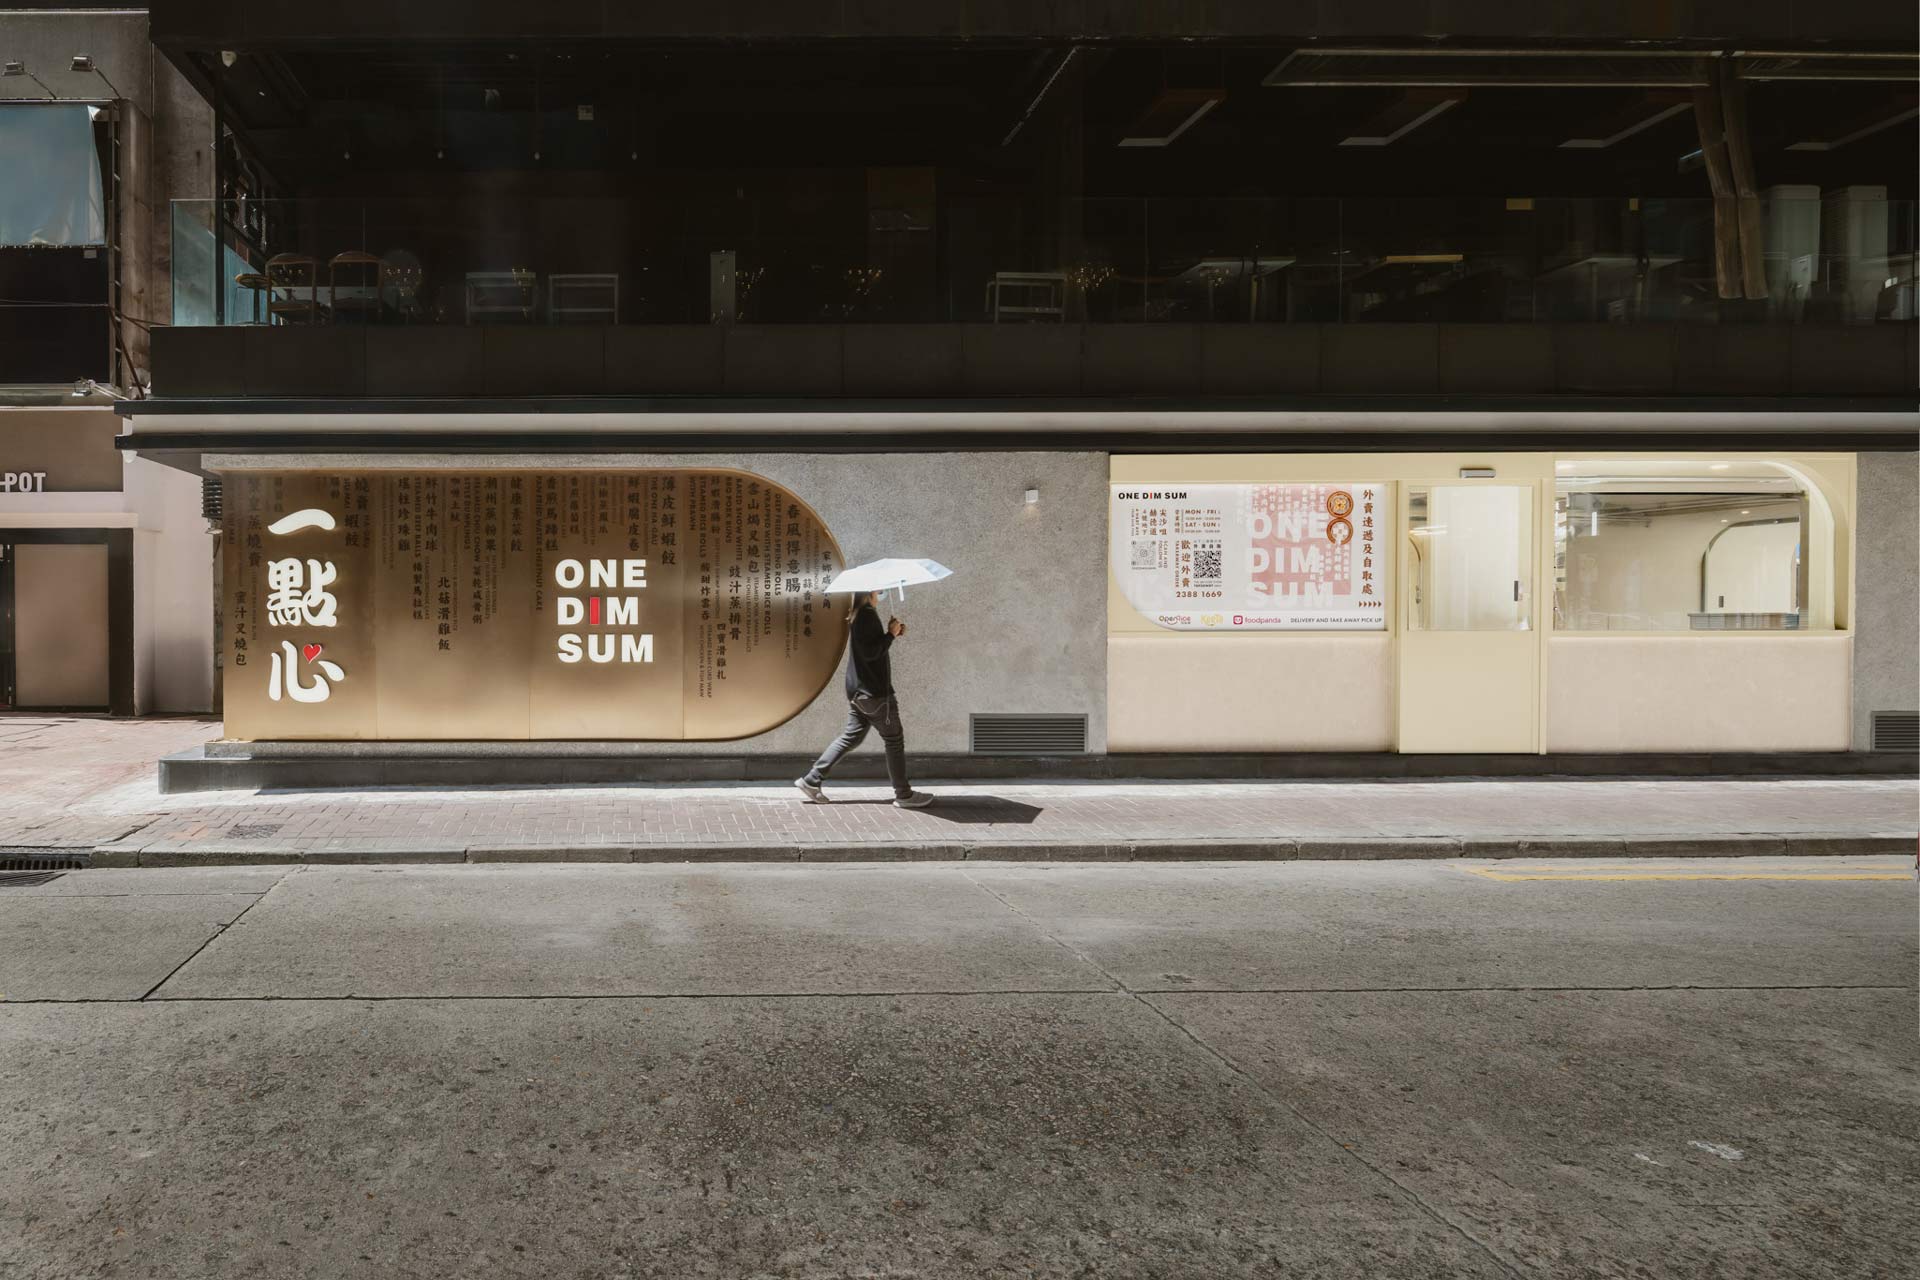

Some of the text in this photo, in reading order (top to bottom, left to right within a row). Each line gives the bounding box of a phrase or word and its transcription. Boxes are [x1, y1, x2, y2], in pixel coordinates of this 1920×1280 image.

[1118, 492, 1187, 500] ONE DIM SUM
[661, 476, 676, 565] 薄皮鮮蝦餃
[774, 538, 782, 569] SPRING
[786, 504, 801, 593] 春風得意腸
[1362, 489, 1374, 595] 外賣速遞及自取處
[555, 559, 647, 589] ONE
[1181, 540, 1191, 588] 歡迎外賣
[774, 571, 782, 596] ROLLS
[438, 577, 450, 651] 北菇滑雞飯
[535, 590, 543, 611] CAKE
[557, 597, 638, 625] DIM
[729, 565, 742, 641] 豉汁蒸排骨
[1245, 616, 1281, 624] foodpanda
[557, 633, 653, 663] SUM
